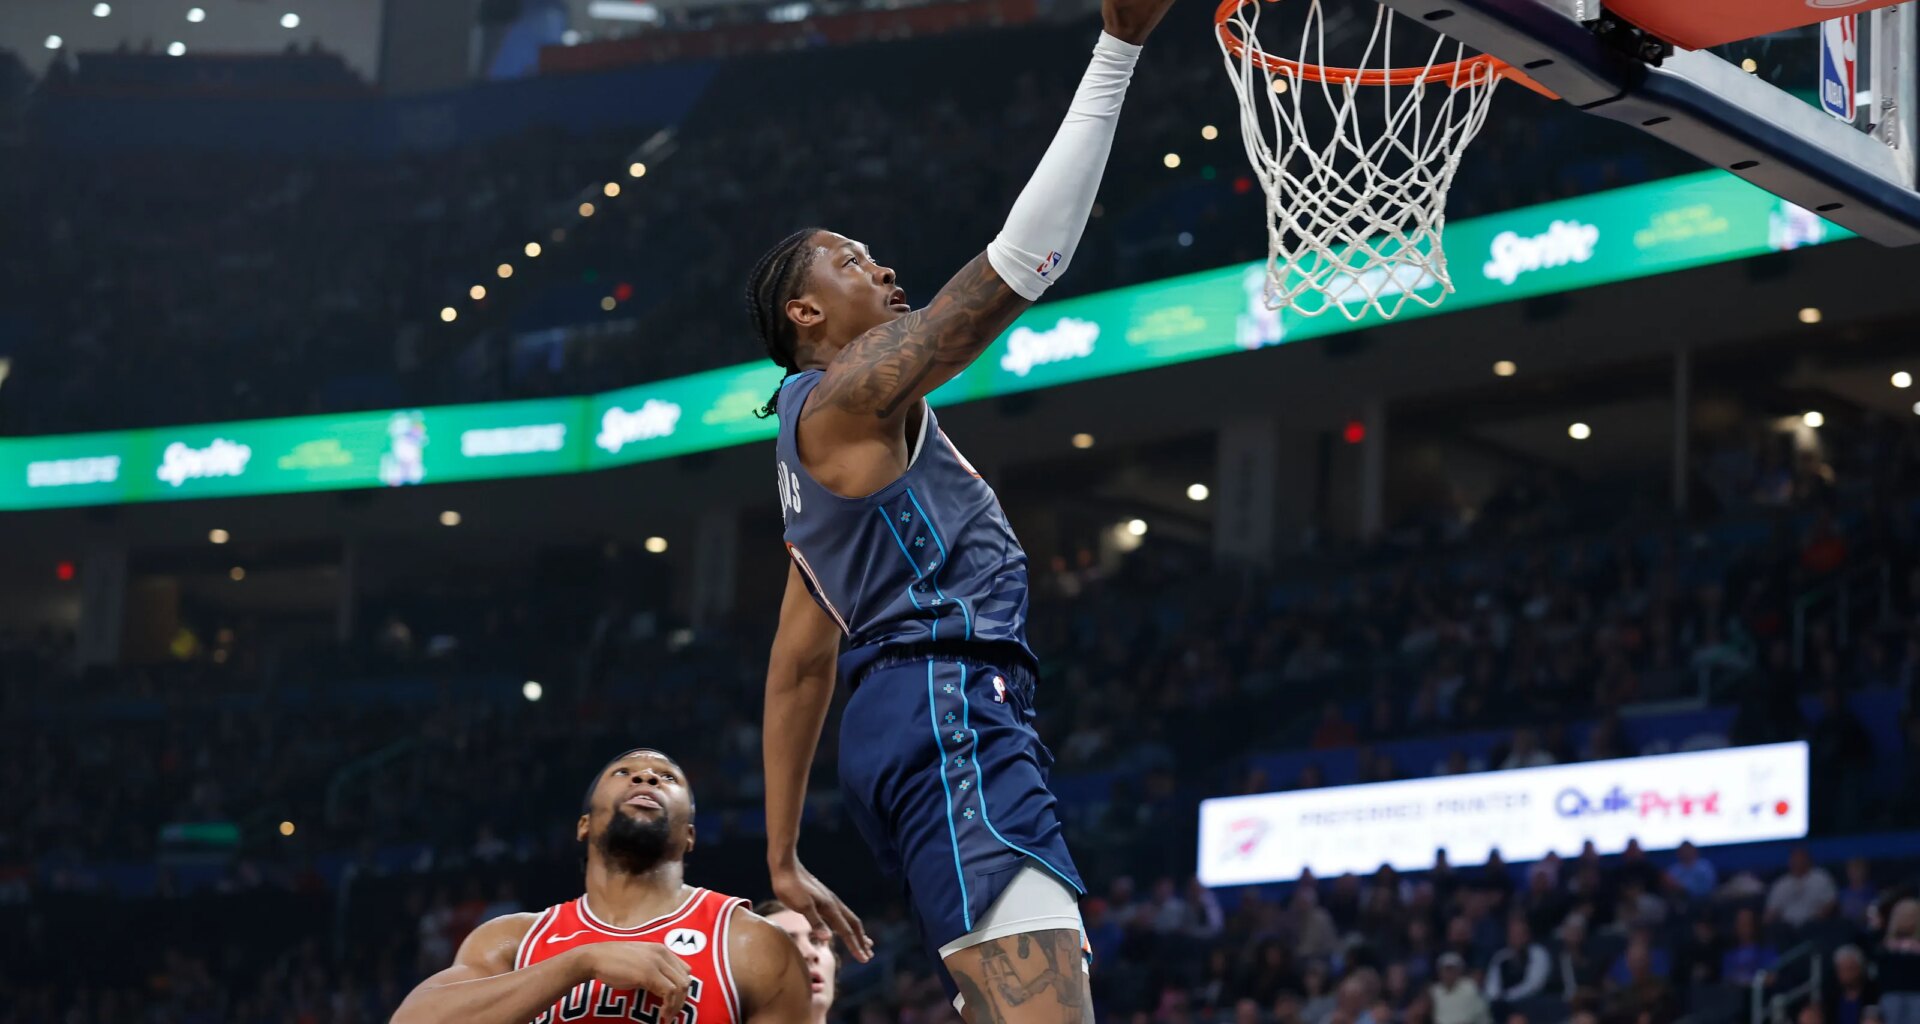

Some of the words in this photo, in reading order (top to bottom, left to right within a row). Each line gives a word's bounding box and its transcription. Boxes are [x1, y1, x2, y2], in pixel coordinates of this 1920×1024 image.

[1484, 221, 1598, 284] Sprite
[1002, 318, 1099, 375] Sprite
[597, 399, 681, 452] Sprite
[158, 439, 251, 486] Sprite
